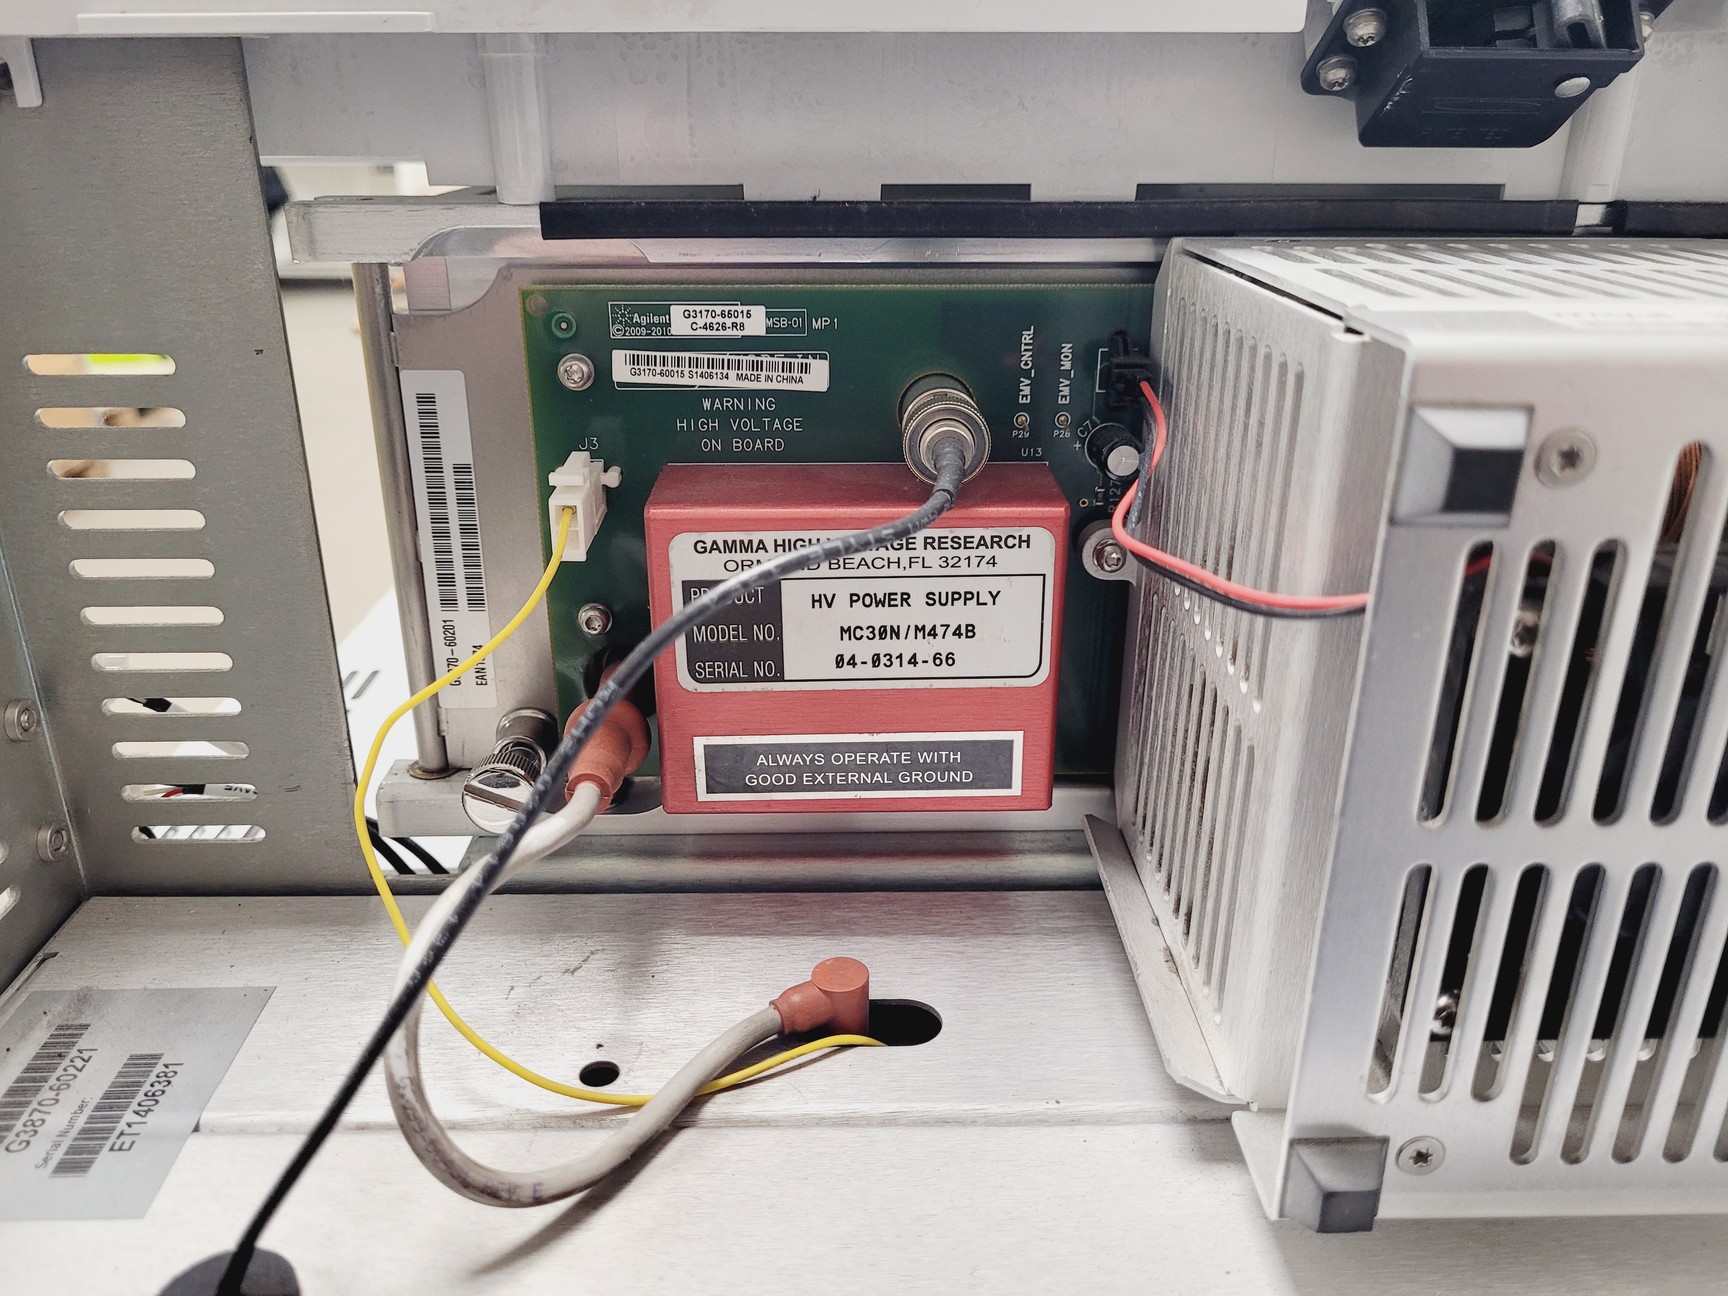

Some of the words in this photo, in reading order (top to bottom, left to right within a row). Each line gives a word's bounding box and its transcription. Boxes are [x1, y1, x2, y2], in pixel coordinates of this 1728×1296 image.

[633, 313, 670, 325] Agilent
[683, 309, 752, 319] G3170-65015
[690, 322, 745, 332] C-4626-R8
[1019, 325, 1035, 404] EMV_CNTRL
[630, 367, 685, 379] G3170-60015
[688, 370, 730, 381] S1406134
[736, 373, 762, 383] MADE
[764, 374, 774, 383] IN
[776, 374, 804, 384] CHINA
[1058, 343, 1074, 404] EMV_MON
[702, 397, 776, 411] WARNING
[676, 418, 719, 431] HIGH
[730, 418, 803, 431] VOLTAGE
[579, 437, 599, 450] J3
[701, 438, 721, 451] ON
[733, 438, 785, 451] BOARD
[1021, 448, 1042, 457] U13
[693, 539, 769, 554] GAMMA
[923, 535, 1032, 551] RESEARCH
[938, 555, 998, 569] 32174
[811, 593, 836, 609] HV
[849, 592, 911, 608] POWER
[925, 590, 1001, 607] SUPPLY
[693, 624, 747, 642] MODEL
[753, 623, 780, 641] NO.
[442, 619, 461, 686] G70-60201
[695, 661, 748, 678] SERIAL
[754, 660, 780, 678] NO.
[756, 753, 825, 767] ALWAYS
[831, 752, 911, 766] OPERATE
[917, 751, 961, 765] WITH
[745, 773, 797, 787] GOOD
[802, 771, 893, 785] EXTERNAL
[898, 770, 973, 784] GROUND
[4, 1048, 98, 1153] G3870-60221
[107, 1062, 184, 1152] ET1406381
[35, 1139, 63, 1170] Serial
